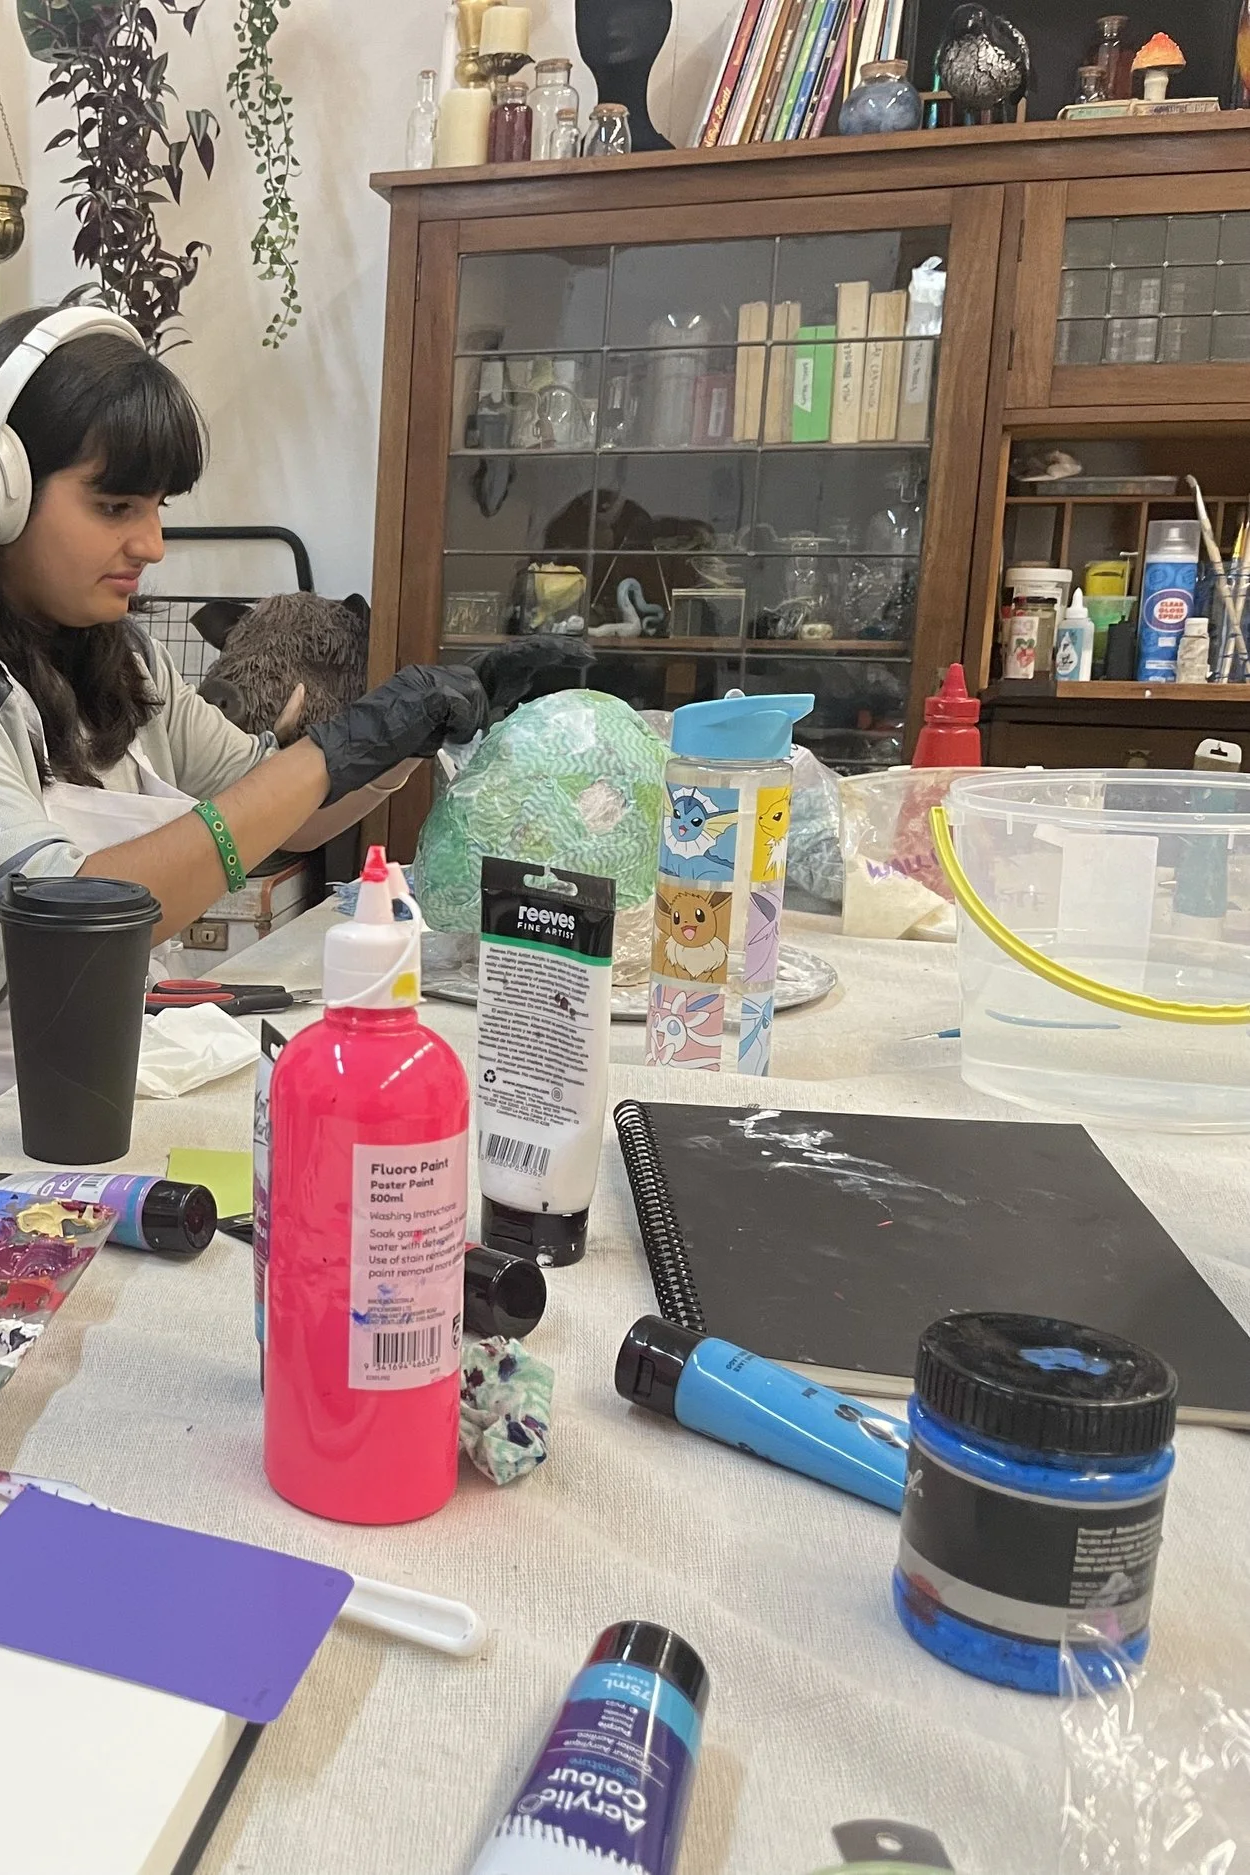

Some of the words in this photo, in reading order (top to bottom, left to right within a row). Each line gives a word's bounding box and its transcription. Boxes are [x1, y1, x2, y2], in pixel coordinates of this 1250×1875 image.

[518, 905, 575, 930] reeves
[517, 921, 541, 933] FINE
[545, 927, 574, 940] ARTIST
[371, 1163, 418, 1175] Fluoro
[420, 1158, 449, 1173] Paint
[370, 1180, 407, 1190] Poster
[409, 1178, 434, 1189] Paint
[370, 1193, 404, 1203] 500ml
[370, 1210, 412, 1223] Washing
[370, 1229, 395, 1238] Soak
[369, 1242, 398, 1252] water
[401, 1240, 420, 1250] with
[368, 1255, 388, 1265] Use
[389, 1255, 400, 1265] of
[401, 1254, 424, 1264] stain
[368, 1268, 395, 1279] paint
[397, 1264, 434, 1277] removal
[363, 1362, 369, 1370] 9
[602, 1678, 651, 1701] 75mL
[597, 1721, 631, 1737] Purple
[613, 1748, 653, 1774] Couleur
[568, 1756, 639, 1785] Signature
[547, 1767, 647, 1812] Colour
[540, 1788, 646, 1833] Acrylic
